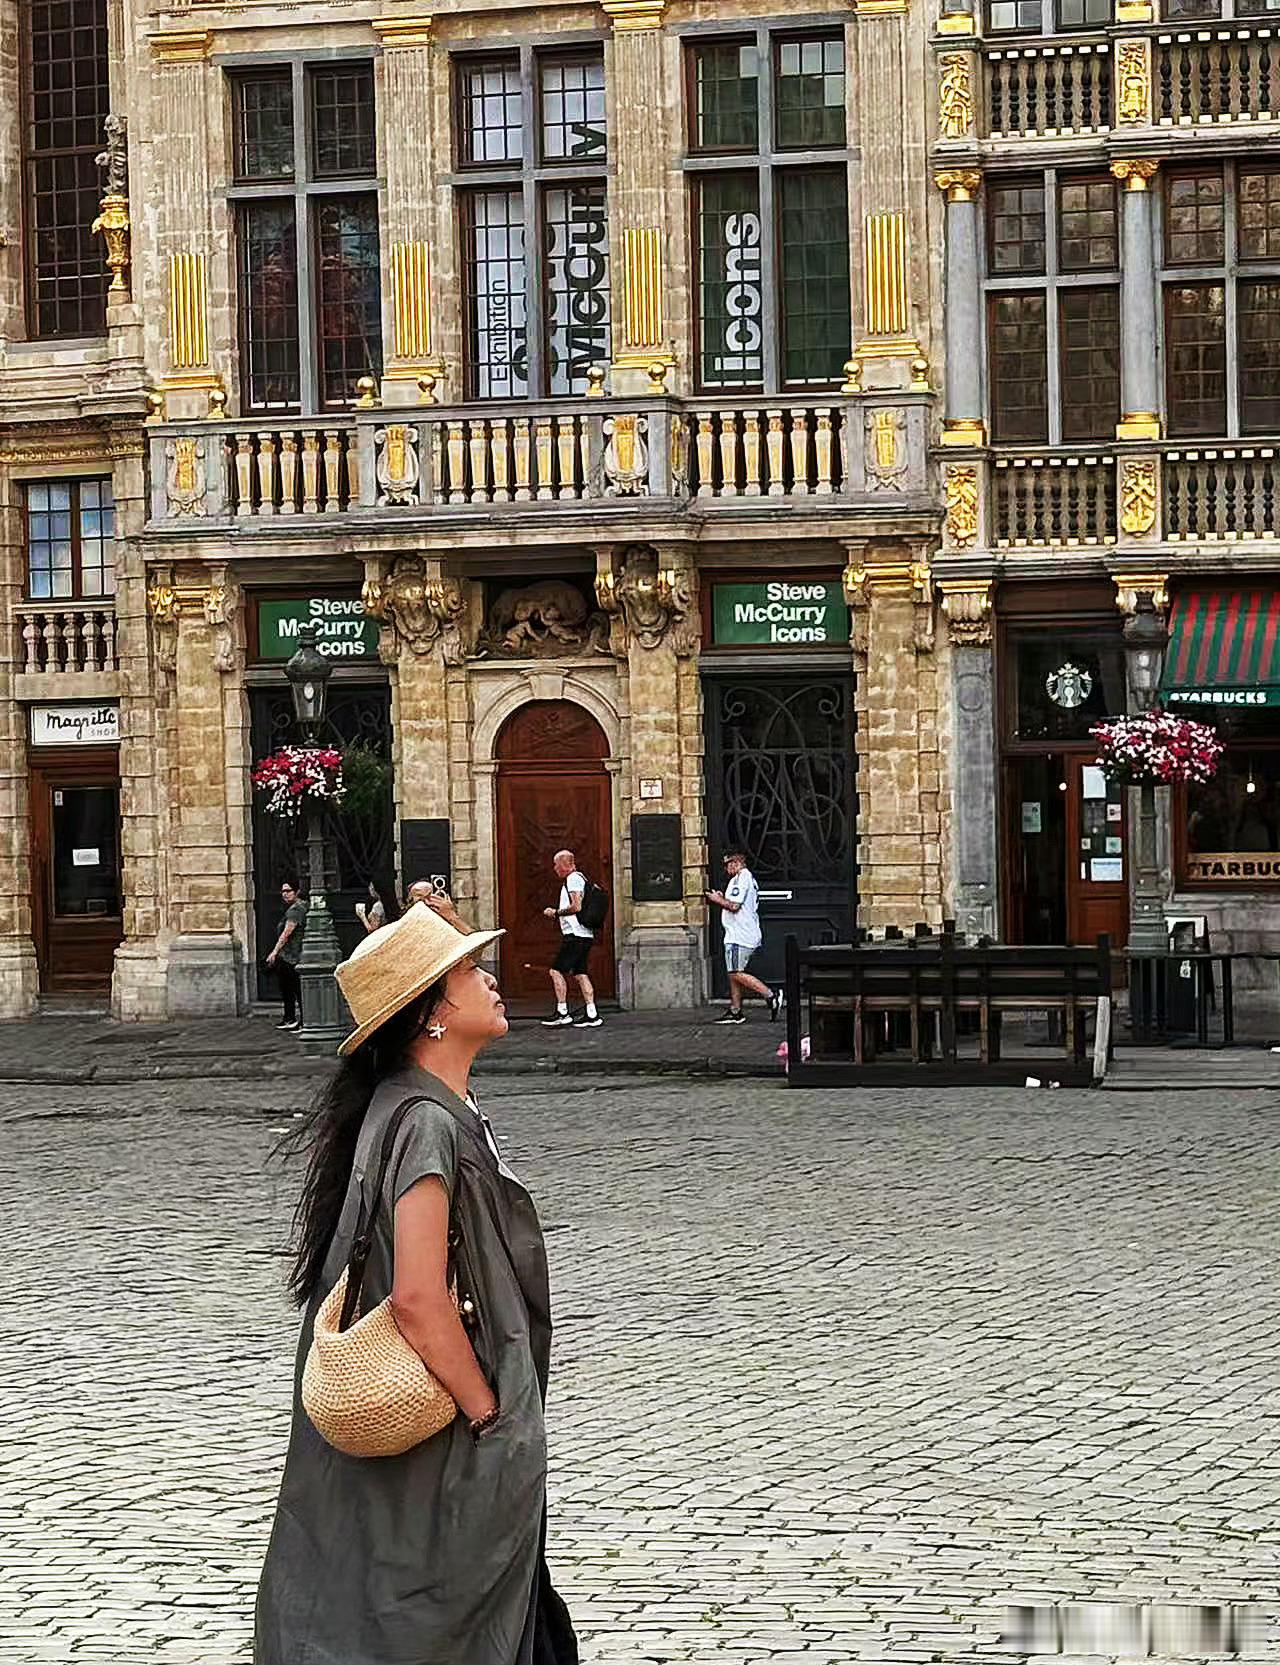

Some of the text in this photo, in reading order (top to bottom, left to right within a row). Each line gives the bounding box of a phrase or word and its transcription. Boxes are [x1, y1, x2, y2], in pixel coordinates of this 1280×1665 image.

[564, 123, 607, 379] McCury
[714, 211, 762, 373] Icons
[489, 279, 508, 381] Exhibition
[767, 582, 826, 601] Steve
[308, 598, 365, 616] Steve
[734, 603, 827, 625] McCurry
[770, 623, 827, 643] Icons
[315, 640, 366, 656] cons
[1169, 691, 1267, 704] STARBUCKS
[90, 728, 117, 737] SHOP
